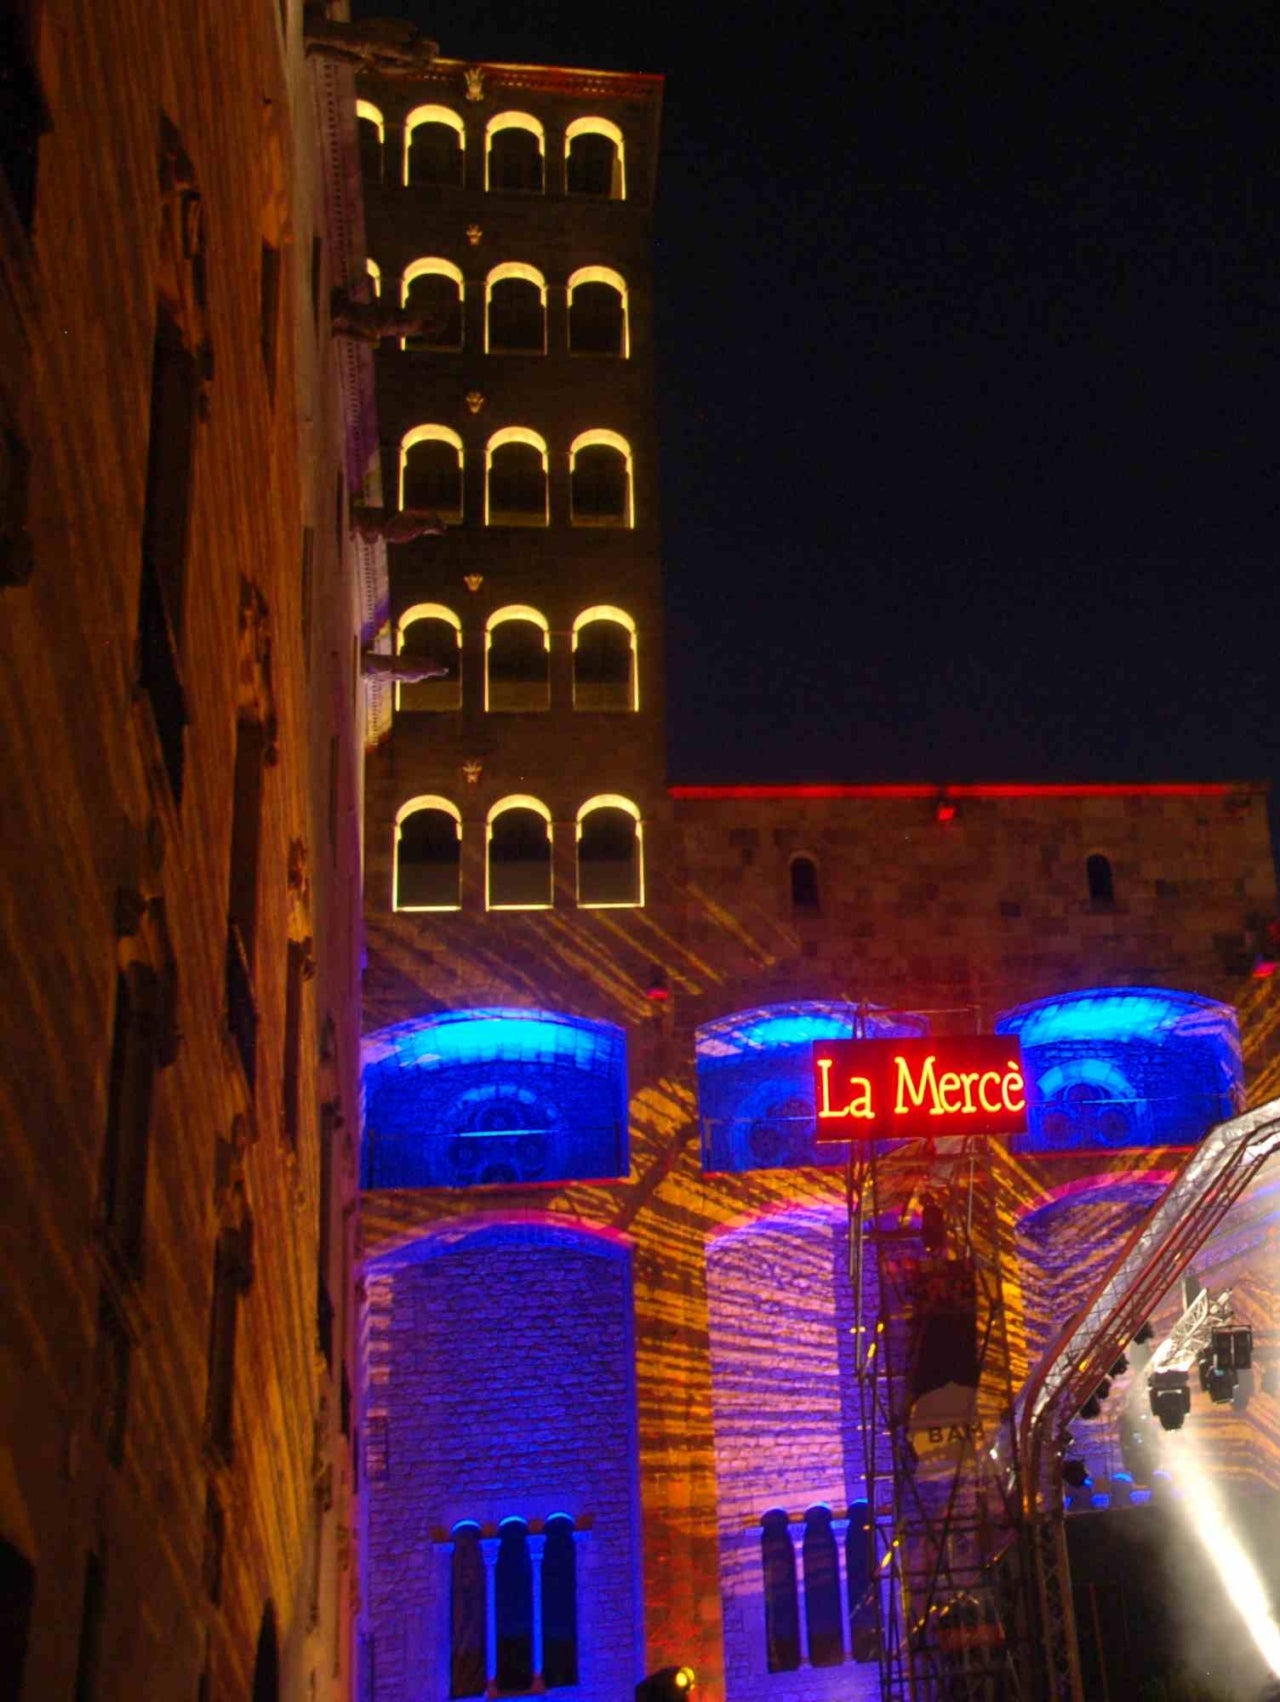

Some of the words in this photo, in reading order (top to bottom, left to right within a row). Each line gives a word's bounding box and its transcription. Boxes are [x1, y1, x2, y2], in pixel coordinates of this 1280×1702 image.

[816, 1058, 876, 1120] La
[894, 1055, 1026, 1116] Mercè
[927, 1422, 985, 1444] BAM
